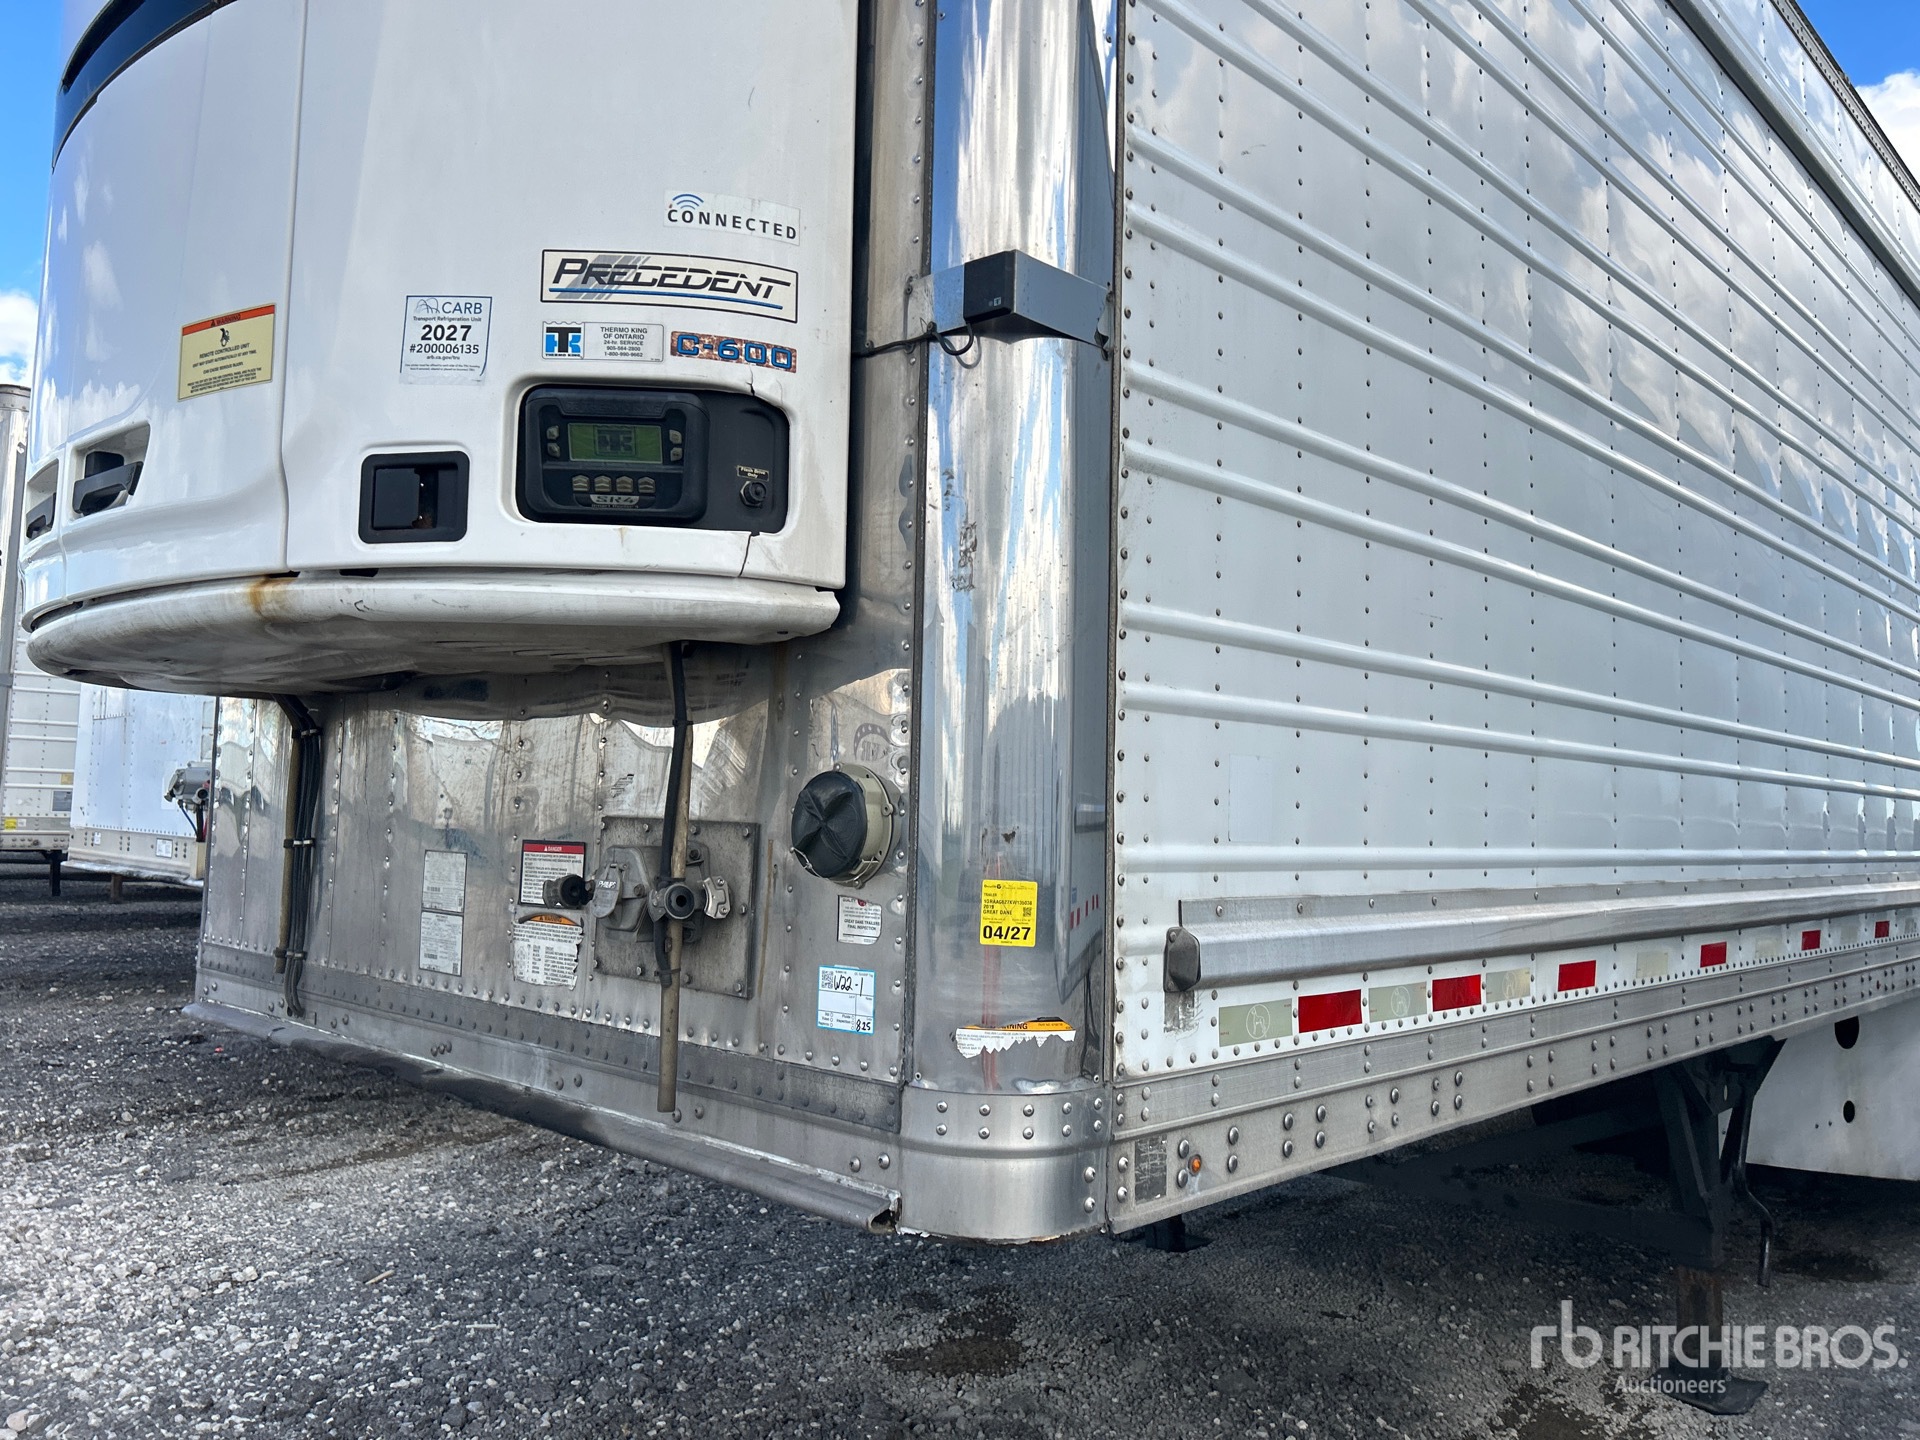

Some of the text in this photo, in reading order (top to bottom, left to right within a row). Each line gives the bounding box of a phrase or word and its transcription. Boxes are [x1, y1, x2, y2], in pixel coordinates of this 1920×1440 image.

[667, 209, 797, 239] CONNECTED
[552, 258, 791, 299] PRECEDENT
[442, 302, 482, 314] CARB
[421, 324, 472, 341] 2027
[409, 343, 480, 354] #200006135
[676, 334, 792, 369] C-600
[595, 495, 636, 503] SR4
[983, 925, 1031, 940] 04/27
